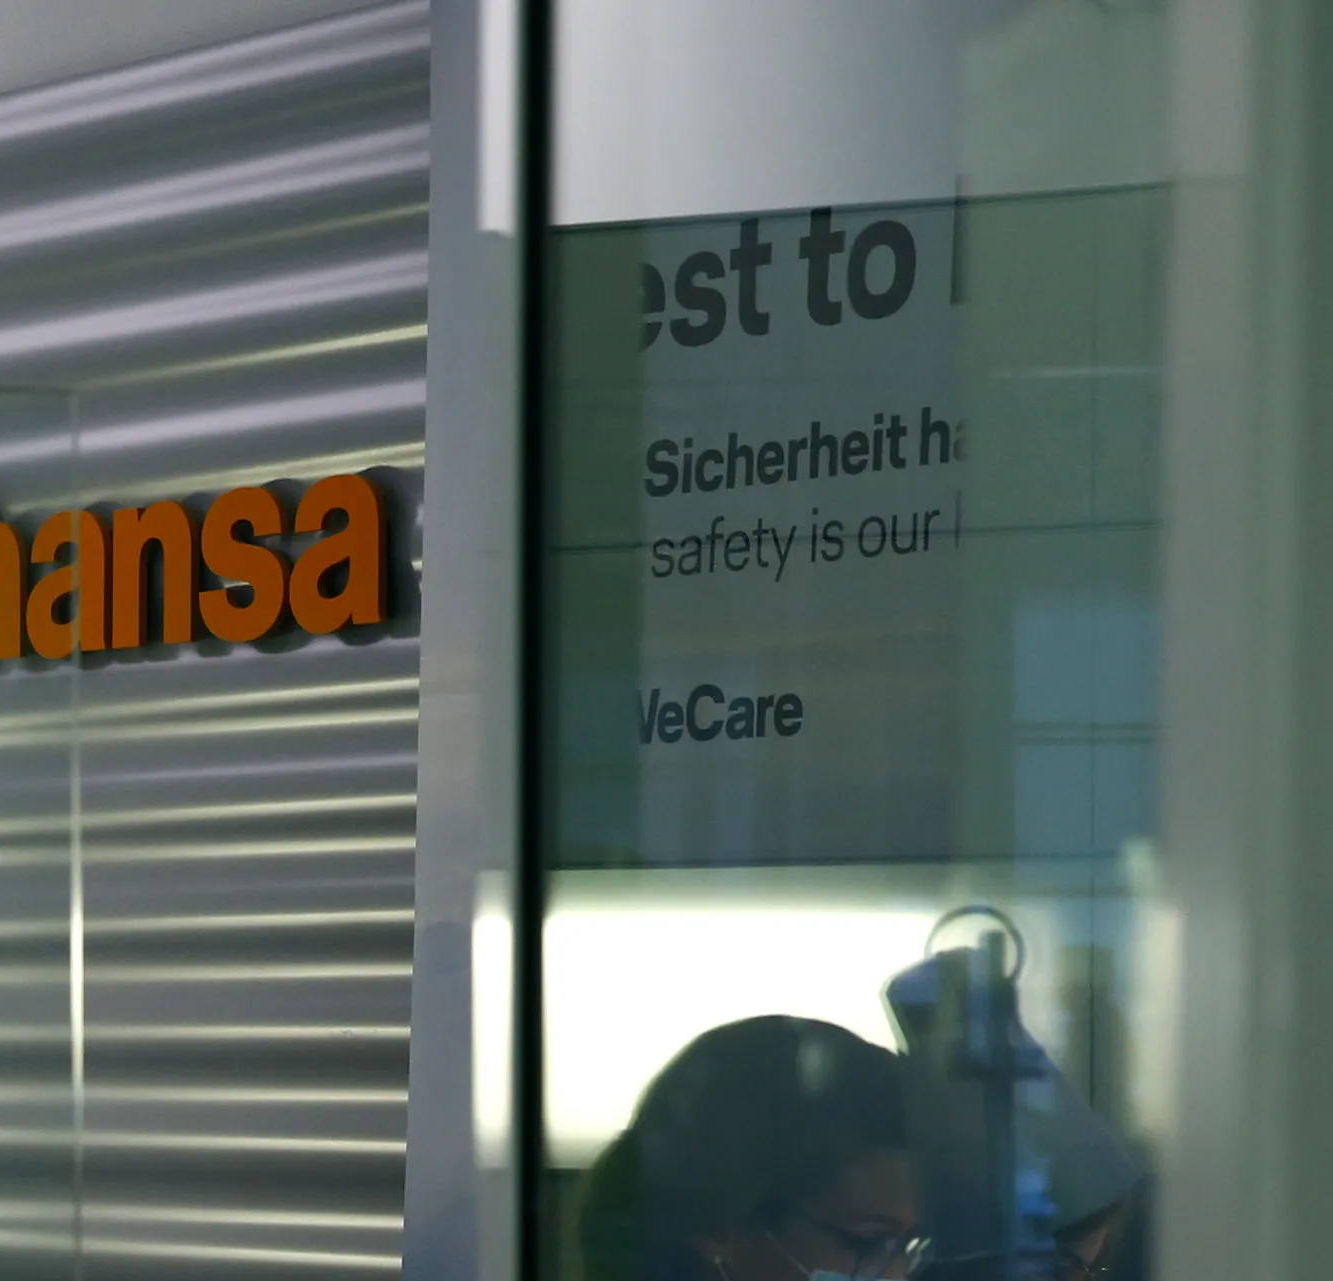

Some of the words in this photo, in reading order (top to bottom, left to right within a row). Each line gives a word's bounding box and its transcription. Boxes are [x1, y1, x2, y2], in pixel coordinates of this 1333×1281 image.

[798, 206, 916, 325] to
[644, 413, 907, 497] Sicherheit
[651, 516, 796, 582] safety
[810, 508, 844, 563] is
[858, 508, 940, 562] our
